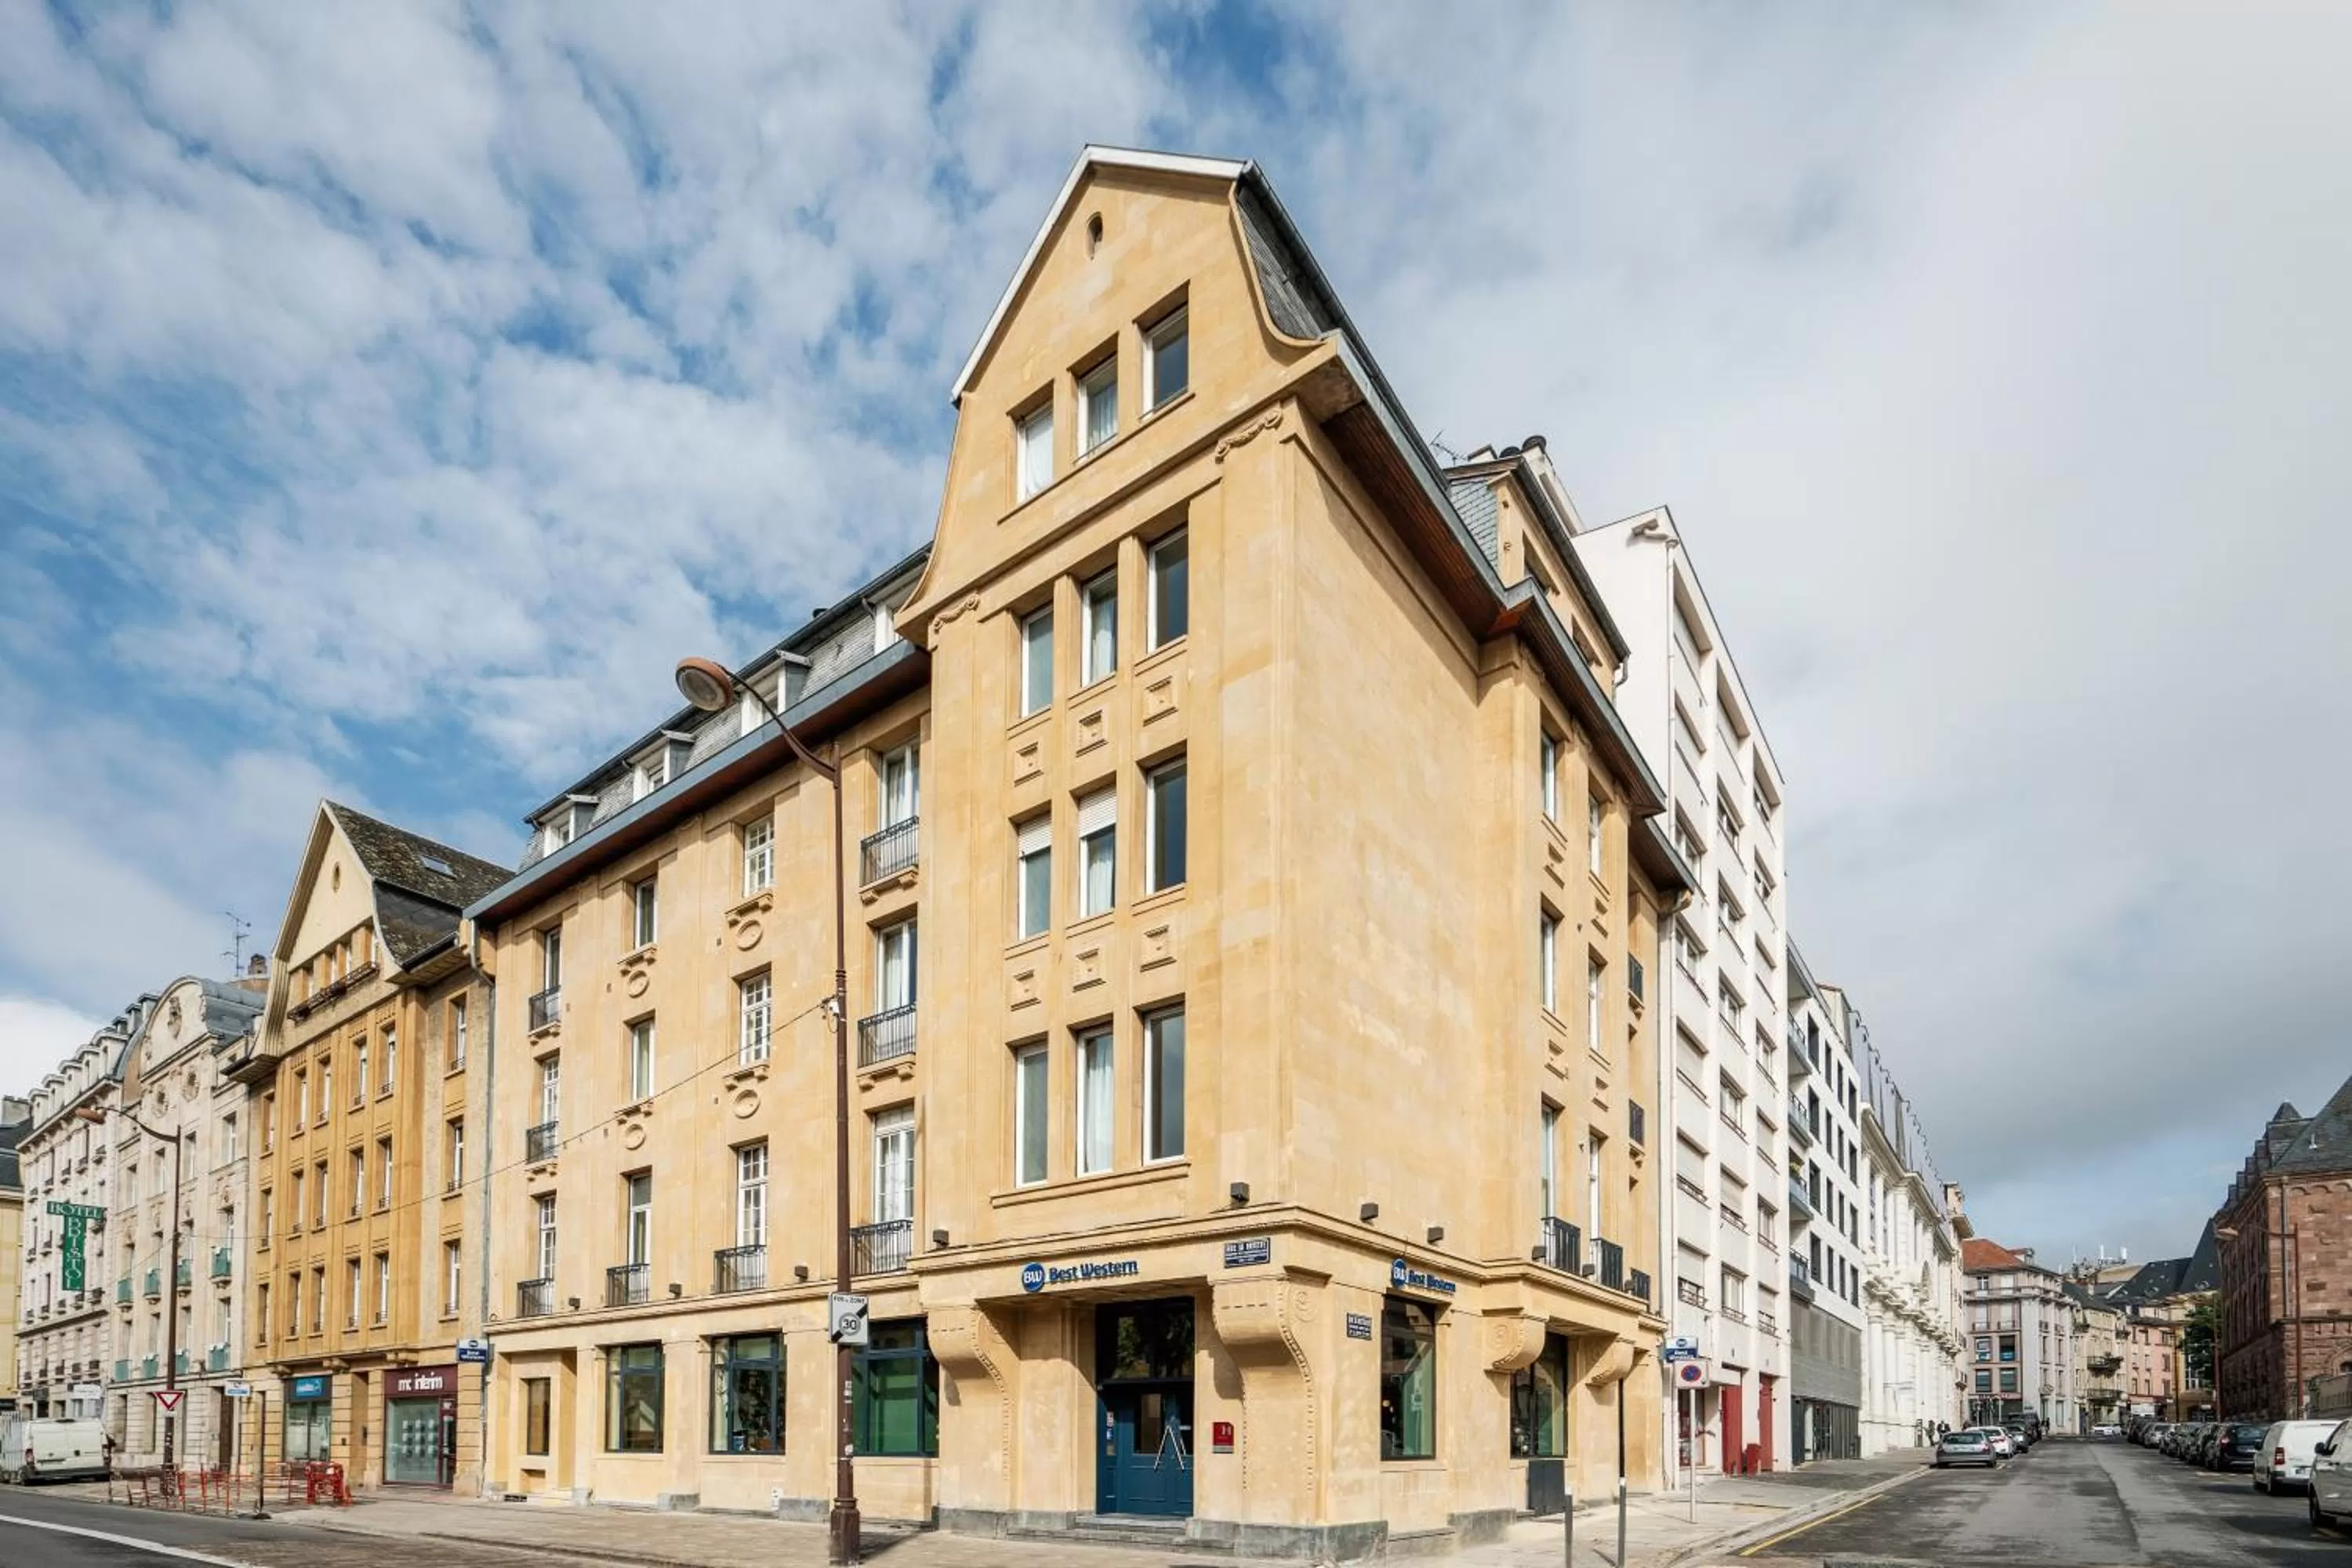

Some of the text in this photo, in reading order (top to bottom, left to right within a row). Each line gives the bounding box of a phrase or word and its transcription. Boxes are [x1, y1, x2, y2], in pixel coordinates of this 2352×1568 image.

[49, 1203, 102, 1219] HOTEL
[65, 1217, 82, 1290] BRISTOL
[1048, 1260, 1138, 1281] Best Western
[843, 1318, 857, 1330] 30
